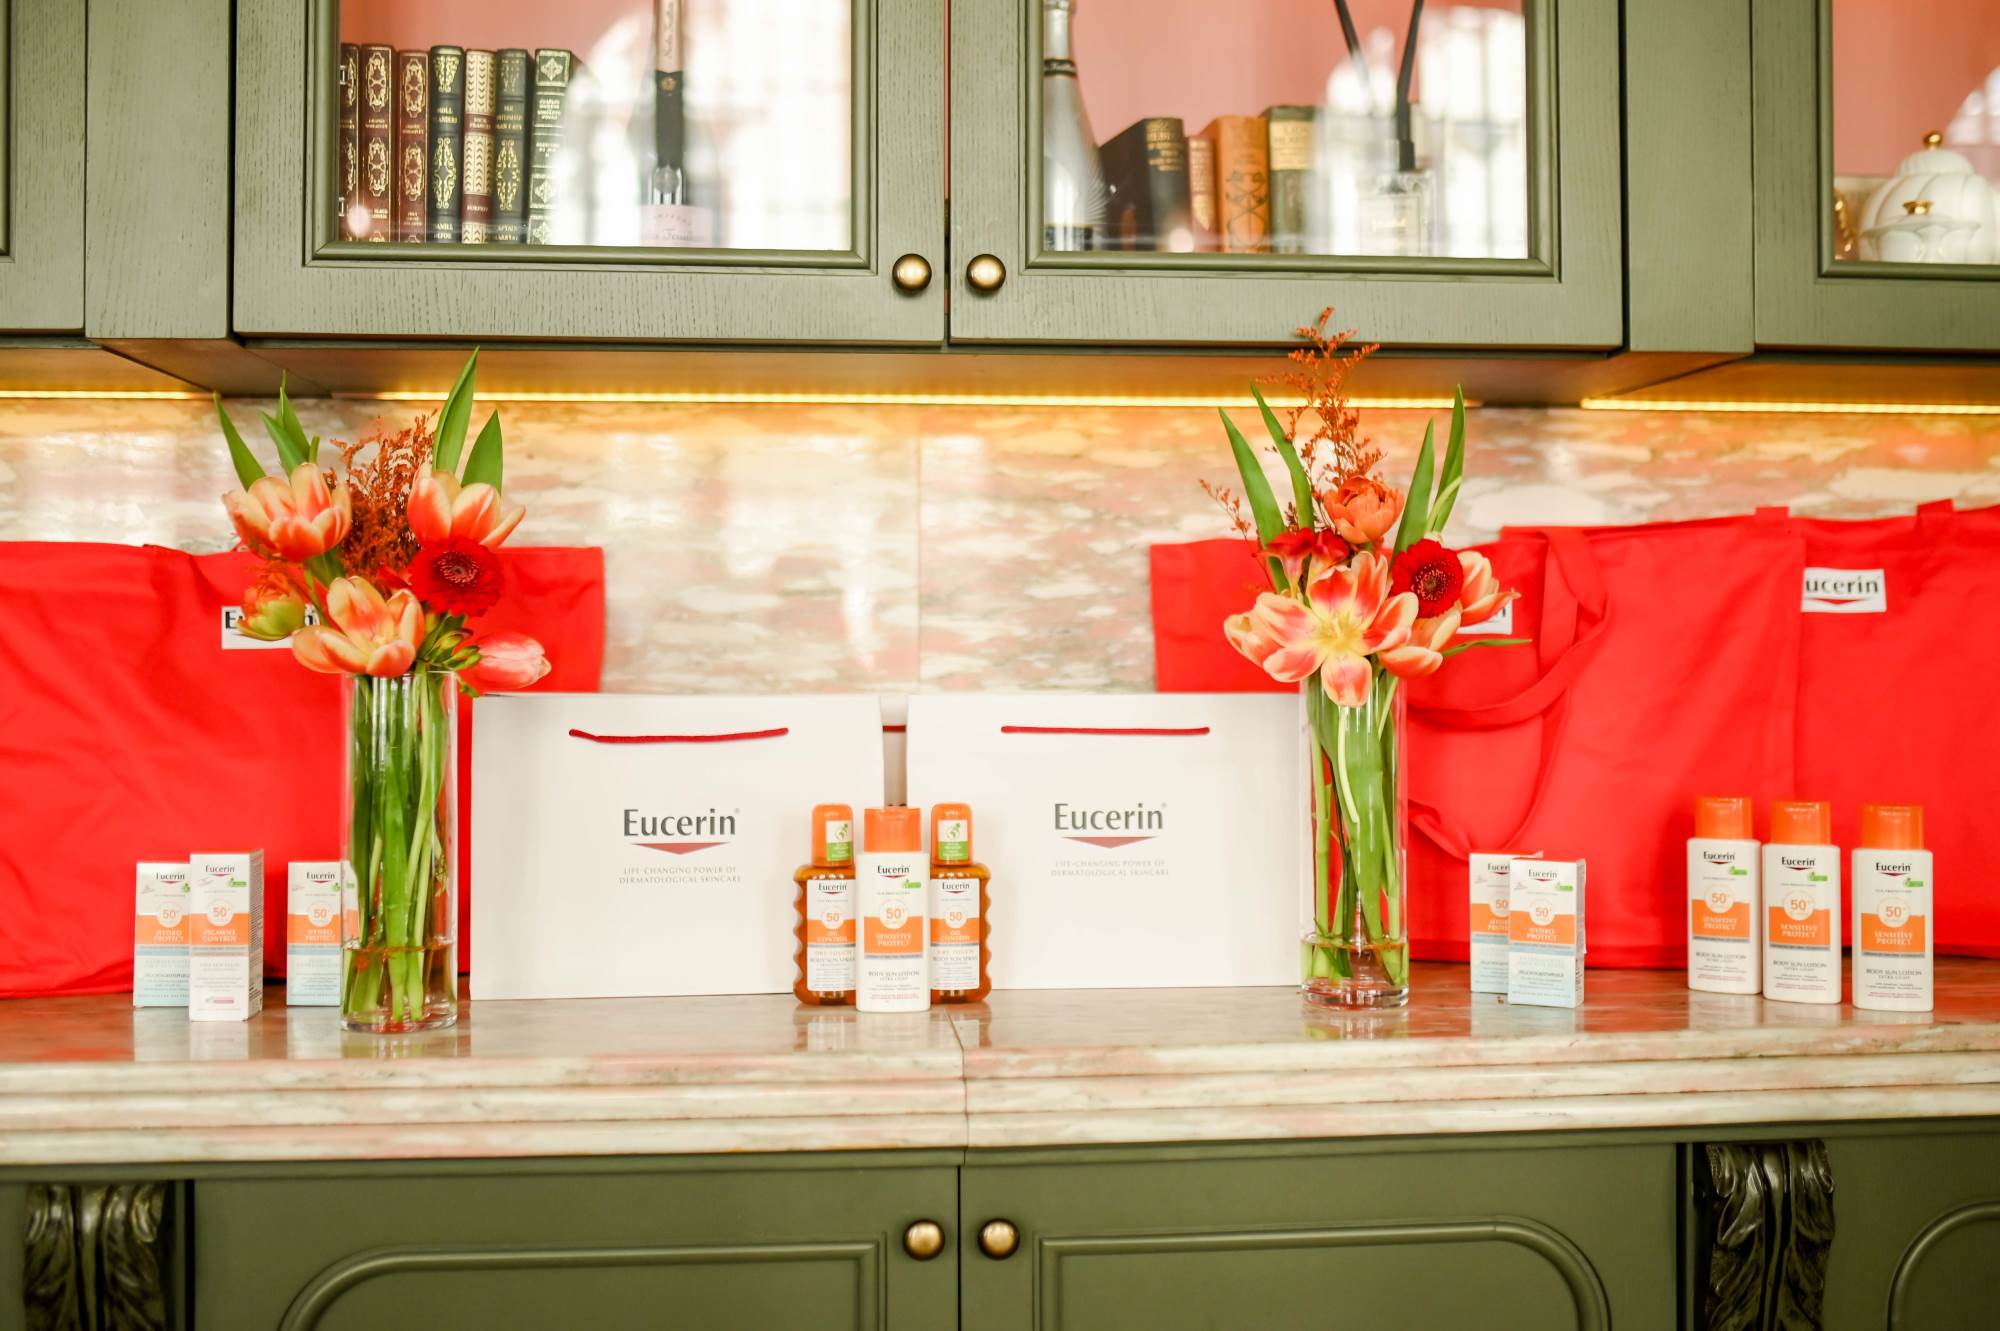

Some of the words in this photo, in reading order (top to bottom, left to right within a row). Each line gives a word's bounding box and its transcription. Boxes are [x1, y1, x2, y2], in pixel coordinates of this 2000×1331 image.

[1805, 576, 1879, 594] ucerin
[1055, 803, 1164, 831] Eucerin
[623, 807, 737, 837] Eucerin
[1703, 851, 1736, 860] Eucerin
[1781, 856, 1816, 866] Eucerin
[205, 865, 236, 873] Eucerin
[877, 865, 910, 874] Eucerin
[1487, 863, 1510, 871] Euceri
[1875, 862, 1912, 872] Eucerin
[156, 872, 186, 880] Eucerin
[306, 872, 336, 880] Eucerin
[1528, 869, 1558, 878] Eucerin
[818, 882, 847, 891] Eucerin
[941, 882, 970, 890] Eucerin
[1781, 930, 1816, 938] PROTECT
[1876, 938, 1912, 946] PROTECT
